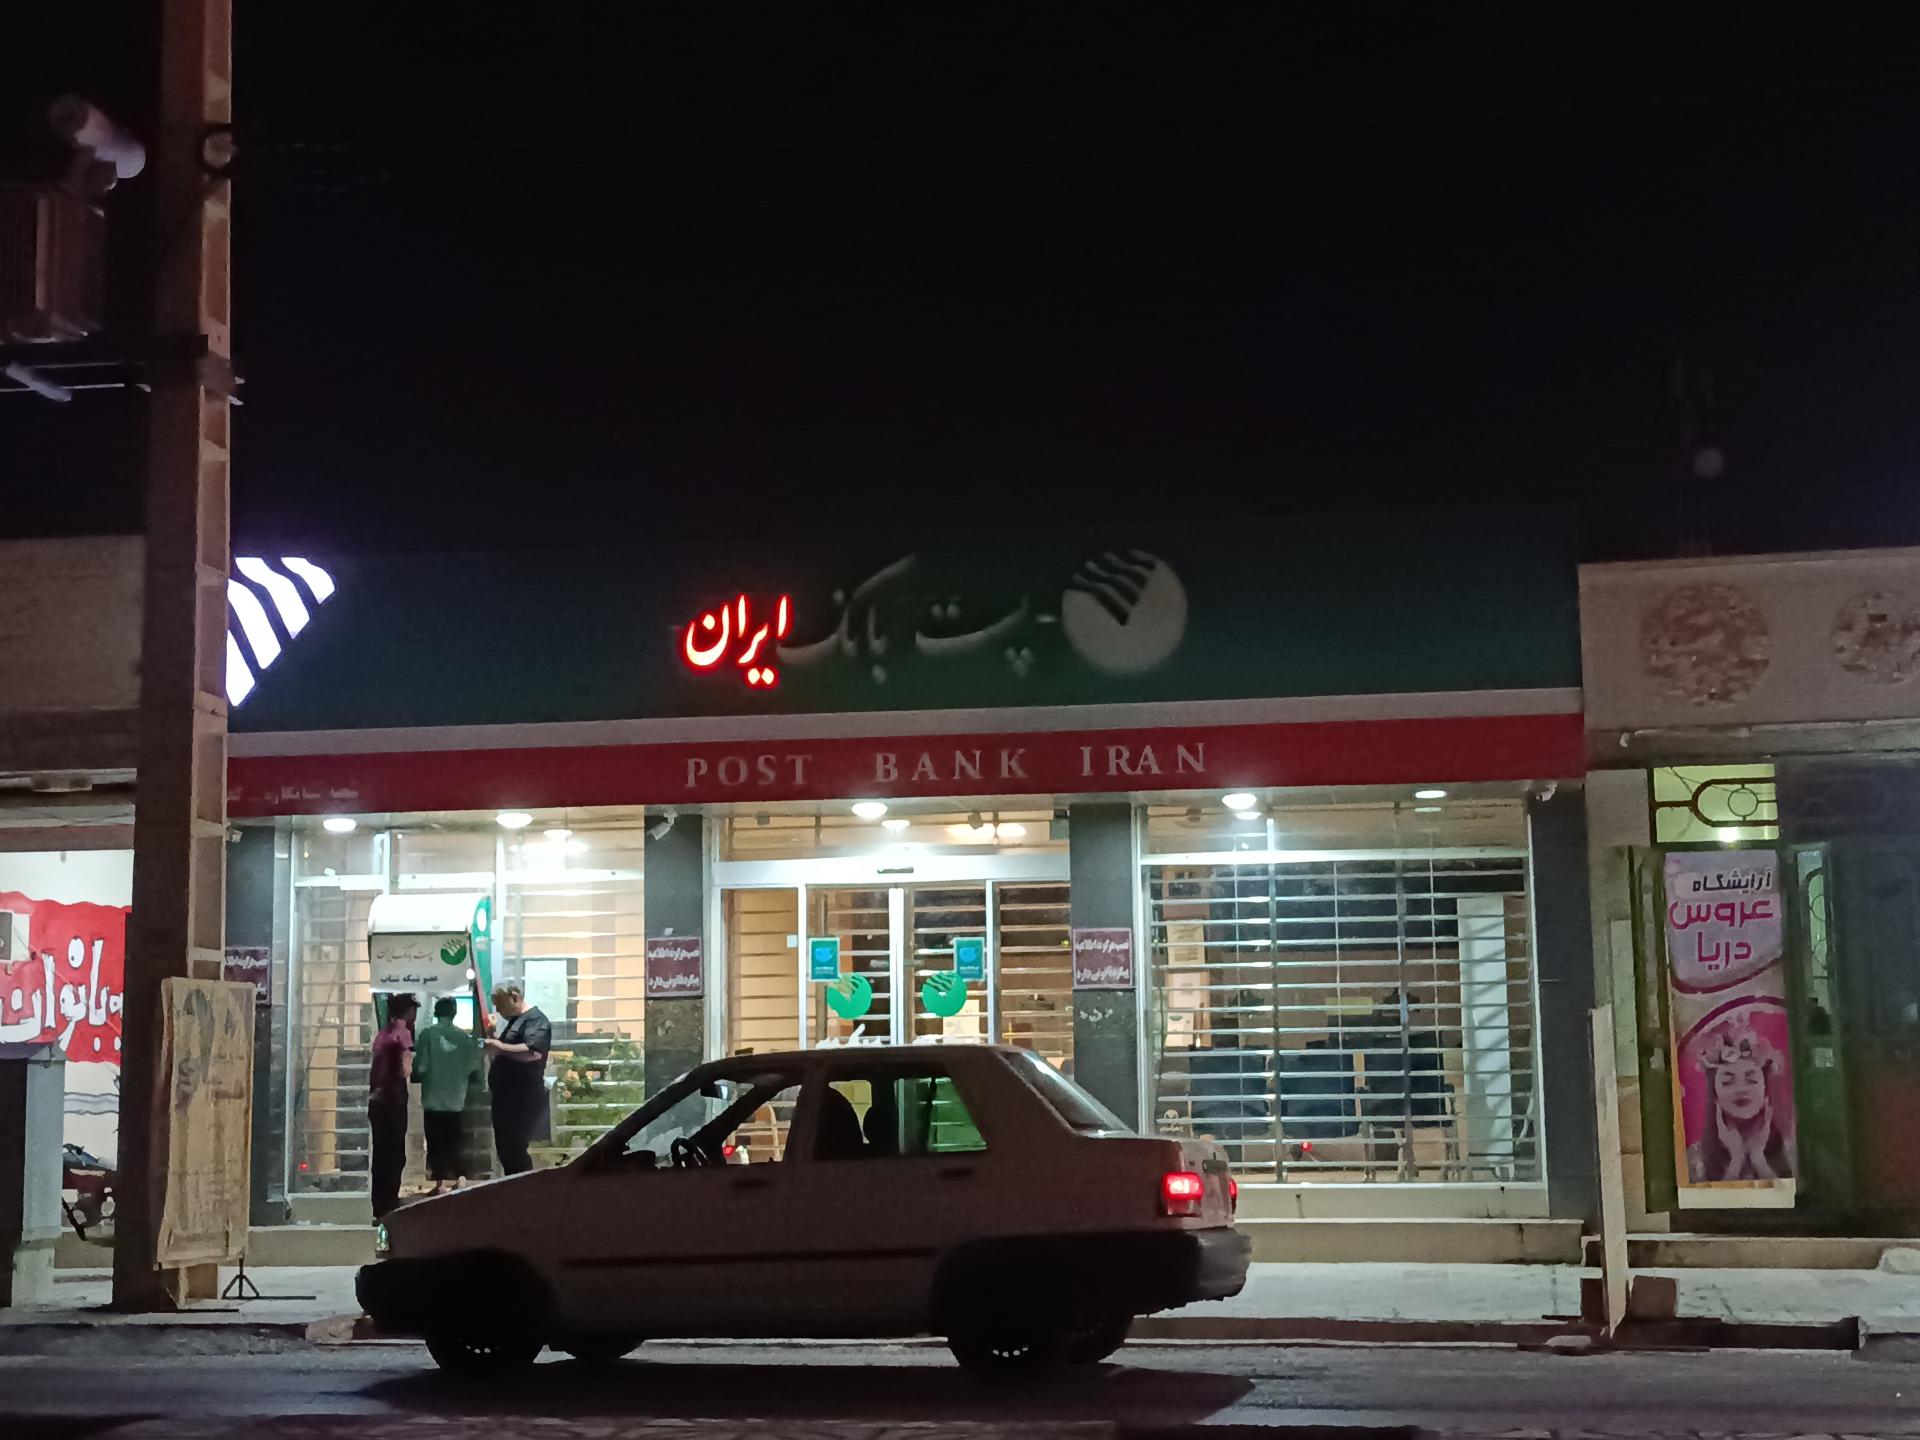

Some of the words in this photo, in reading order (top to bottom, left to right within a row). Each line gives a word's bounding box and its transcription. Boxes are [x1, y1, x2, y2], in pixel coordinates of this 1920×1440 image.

[776, 553, 919, 686] بانک
[683, 594, 792, 688] ایران
[685, 753, 813, 788] POST
[873, 748, 1029, 783] BANK
[1080, 742, 1207, 777] IRAN
[1692, 868, 1772, 893] آرایشگاه
[1668, 900, 1773, 930] عروس
[1697, 932, 1752, 971] دریا
